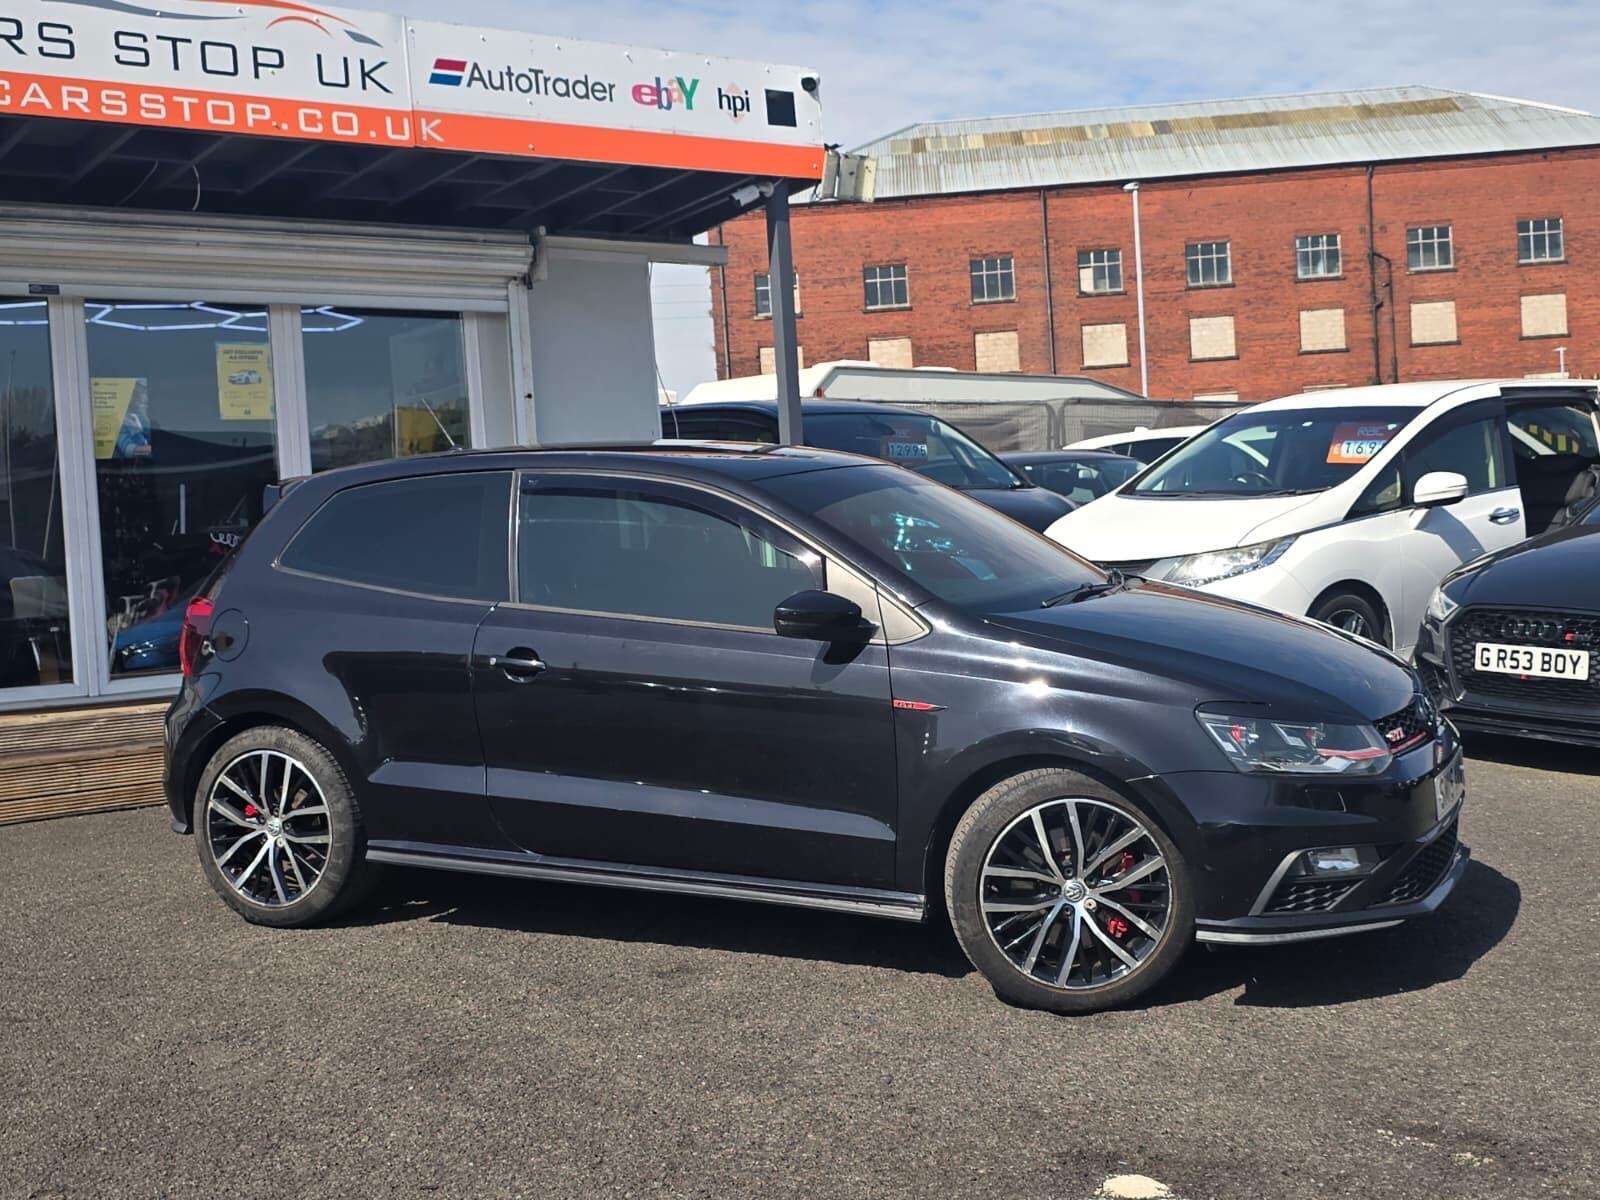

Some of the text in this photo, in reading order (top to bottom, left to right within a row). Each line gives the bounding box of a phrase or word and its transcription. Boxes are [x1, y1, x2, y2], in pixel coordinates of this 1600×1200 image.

[114, 30, 285, 79] STOP
[316, 53, 393, 94] UK
[466, 61, 615, 102] AutoTrader
[717, 87, 751, 118] hpi
[890, 444, 926, 457] 12995
[1541, 652, 1581, 675] BOY
